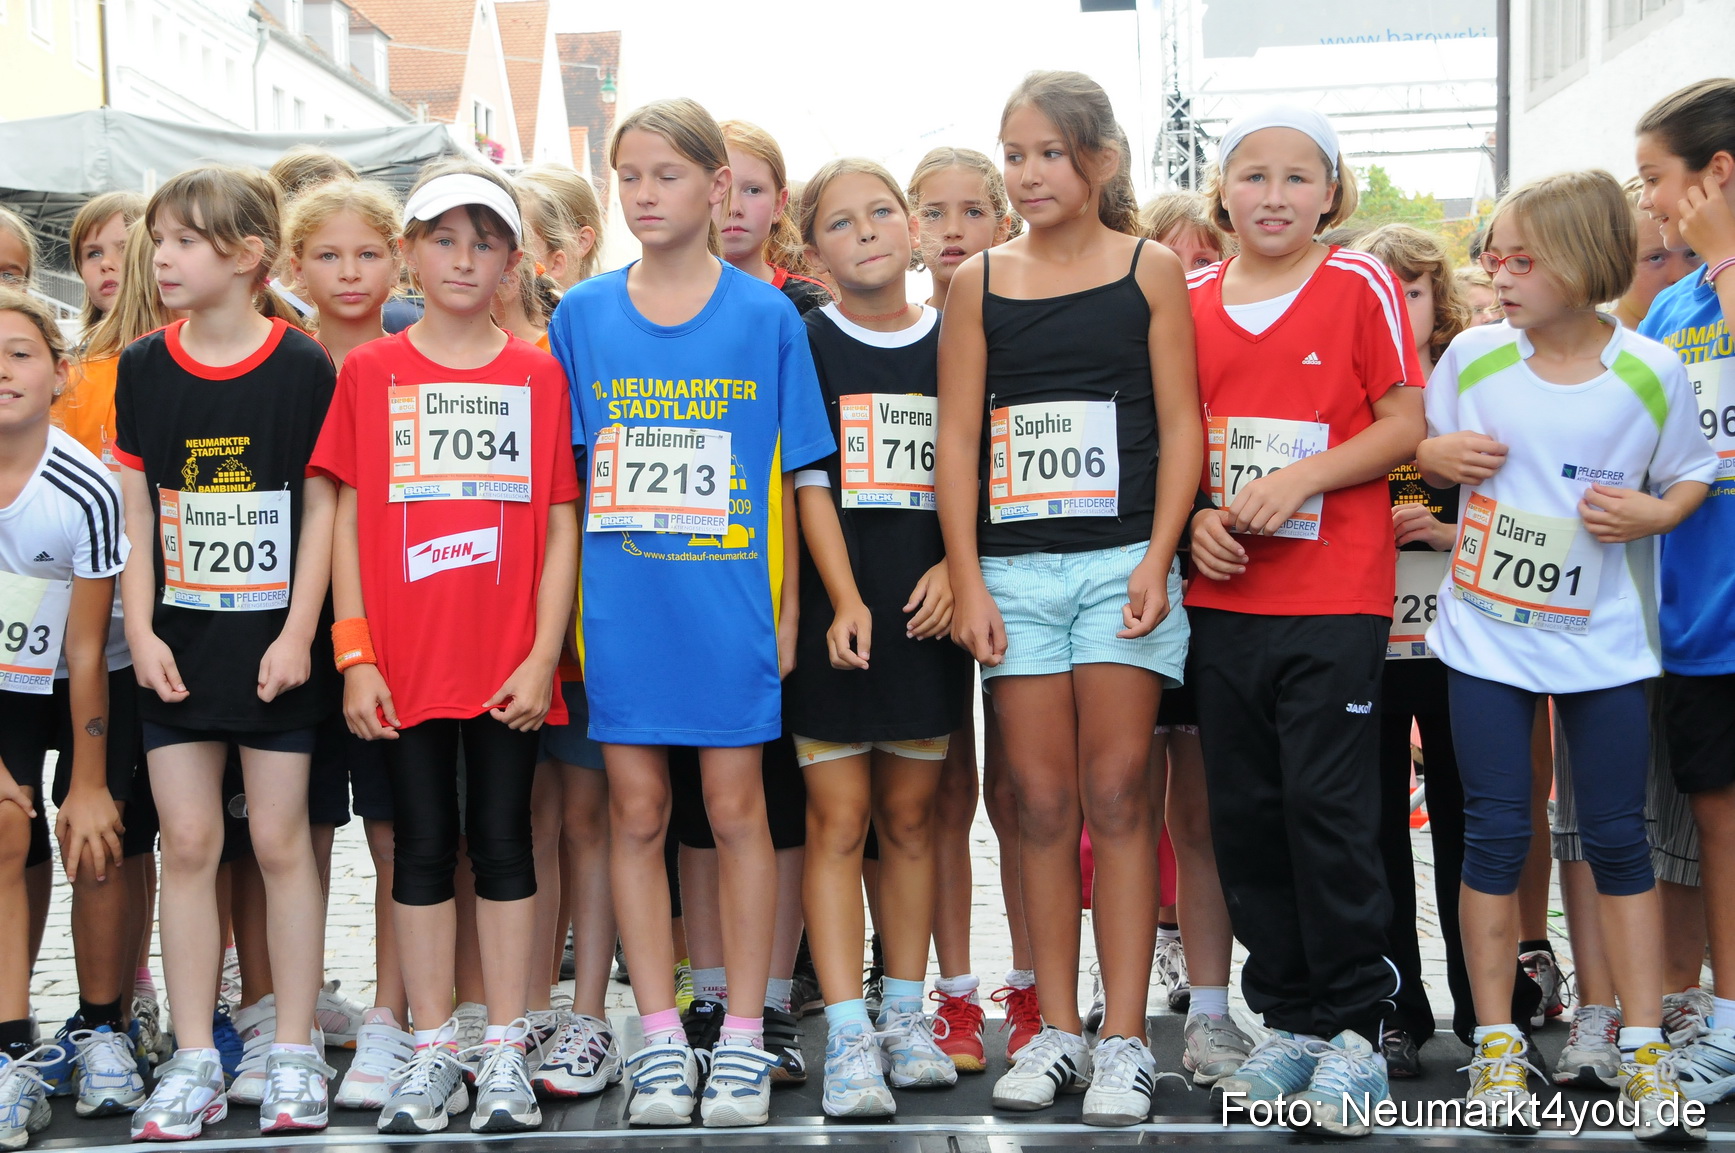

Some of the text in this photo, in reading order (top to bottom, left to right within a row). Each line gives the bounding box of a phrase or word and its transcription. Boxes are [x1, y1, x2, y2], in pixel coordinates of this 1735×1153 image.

[612, 378, 757, 400] NEUMARKTER
[426, 393, 509, 416] Christina
[608, 399, 729, 420] STADTLAUF
[879, 403, 932, 426] Verena
[1014, 412, 1072, 439] Sophie
[1699, 405, 1735, 440] 96
[185, 436, 251, 448] NEUMARKTER
[395, 430, 411, 446] K5
[429, 428, 519, 462] 7034
[625, 427, 706, 450] Fabienne
[848, 436, 864, 452] K5
[1230, 427, 1262, 450] Ann-
[190, 446, 245, 458] STADTLAUF
[882, 439, 935, 472] 716
[993, 452, 1004, 469] K5
[596, 461, 610, 478] K5
[1018, 446, 1106, 481] 7006
[1210, 461, 1220, 478] K5
[1577, 466, 1624, 481] PFLEIDERER
[478, 482, 529, 493] PFLEIDERER
[625, 461, 716, 497] 7213
[728, 498, 752, 515] 009
[1063, 498, 1115, 508] PFLEIDERER
[185, 503, 279, 526] Anna-Lena
[670, 515, 725, 527] PFLEIDERER
[1496, 513, 1547, 547] Clara
[164, 534, 177, 552] K5
[432, 541, 473, 563] DEHN
[1461, 535, 1478, 555] K5
[188, 540, 278, 573] 7203
[643, 551, 758, 561] www.stadtlauf-neumarkt.de
[1492, 549, 1582, 596] 7091
[236, 590, 287, 602] PFLEIDERER
[1394, 594, 1437, 624] 28
[1531, 611, 1588, 626] PFLEIDERER
[0, 618, 51, 655] 93
